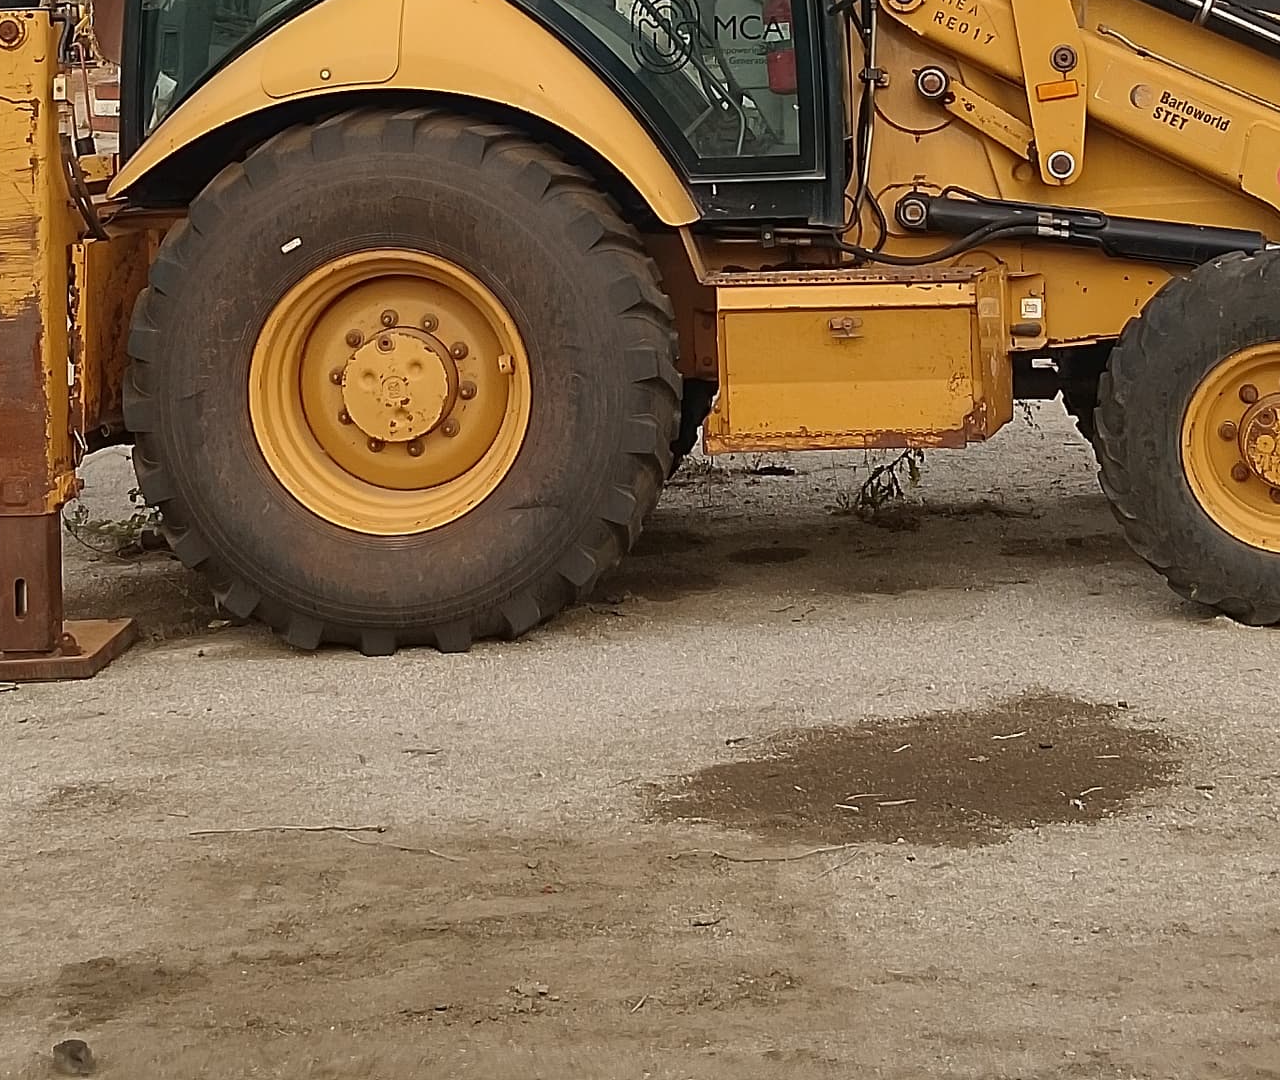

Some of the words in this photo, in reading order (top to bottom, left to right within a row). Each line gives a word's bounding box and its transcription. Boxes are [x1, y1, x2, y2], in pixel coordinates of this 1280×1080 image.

[713, 15, 785, 41] MCA
[1152, 106, 1189, 131] STET
[1159, 90, 1231, 132] Barloworld
